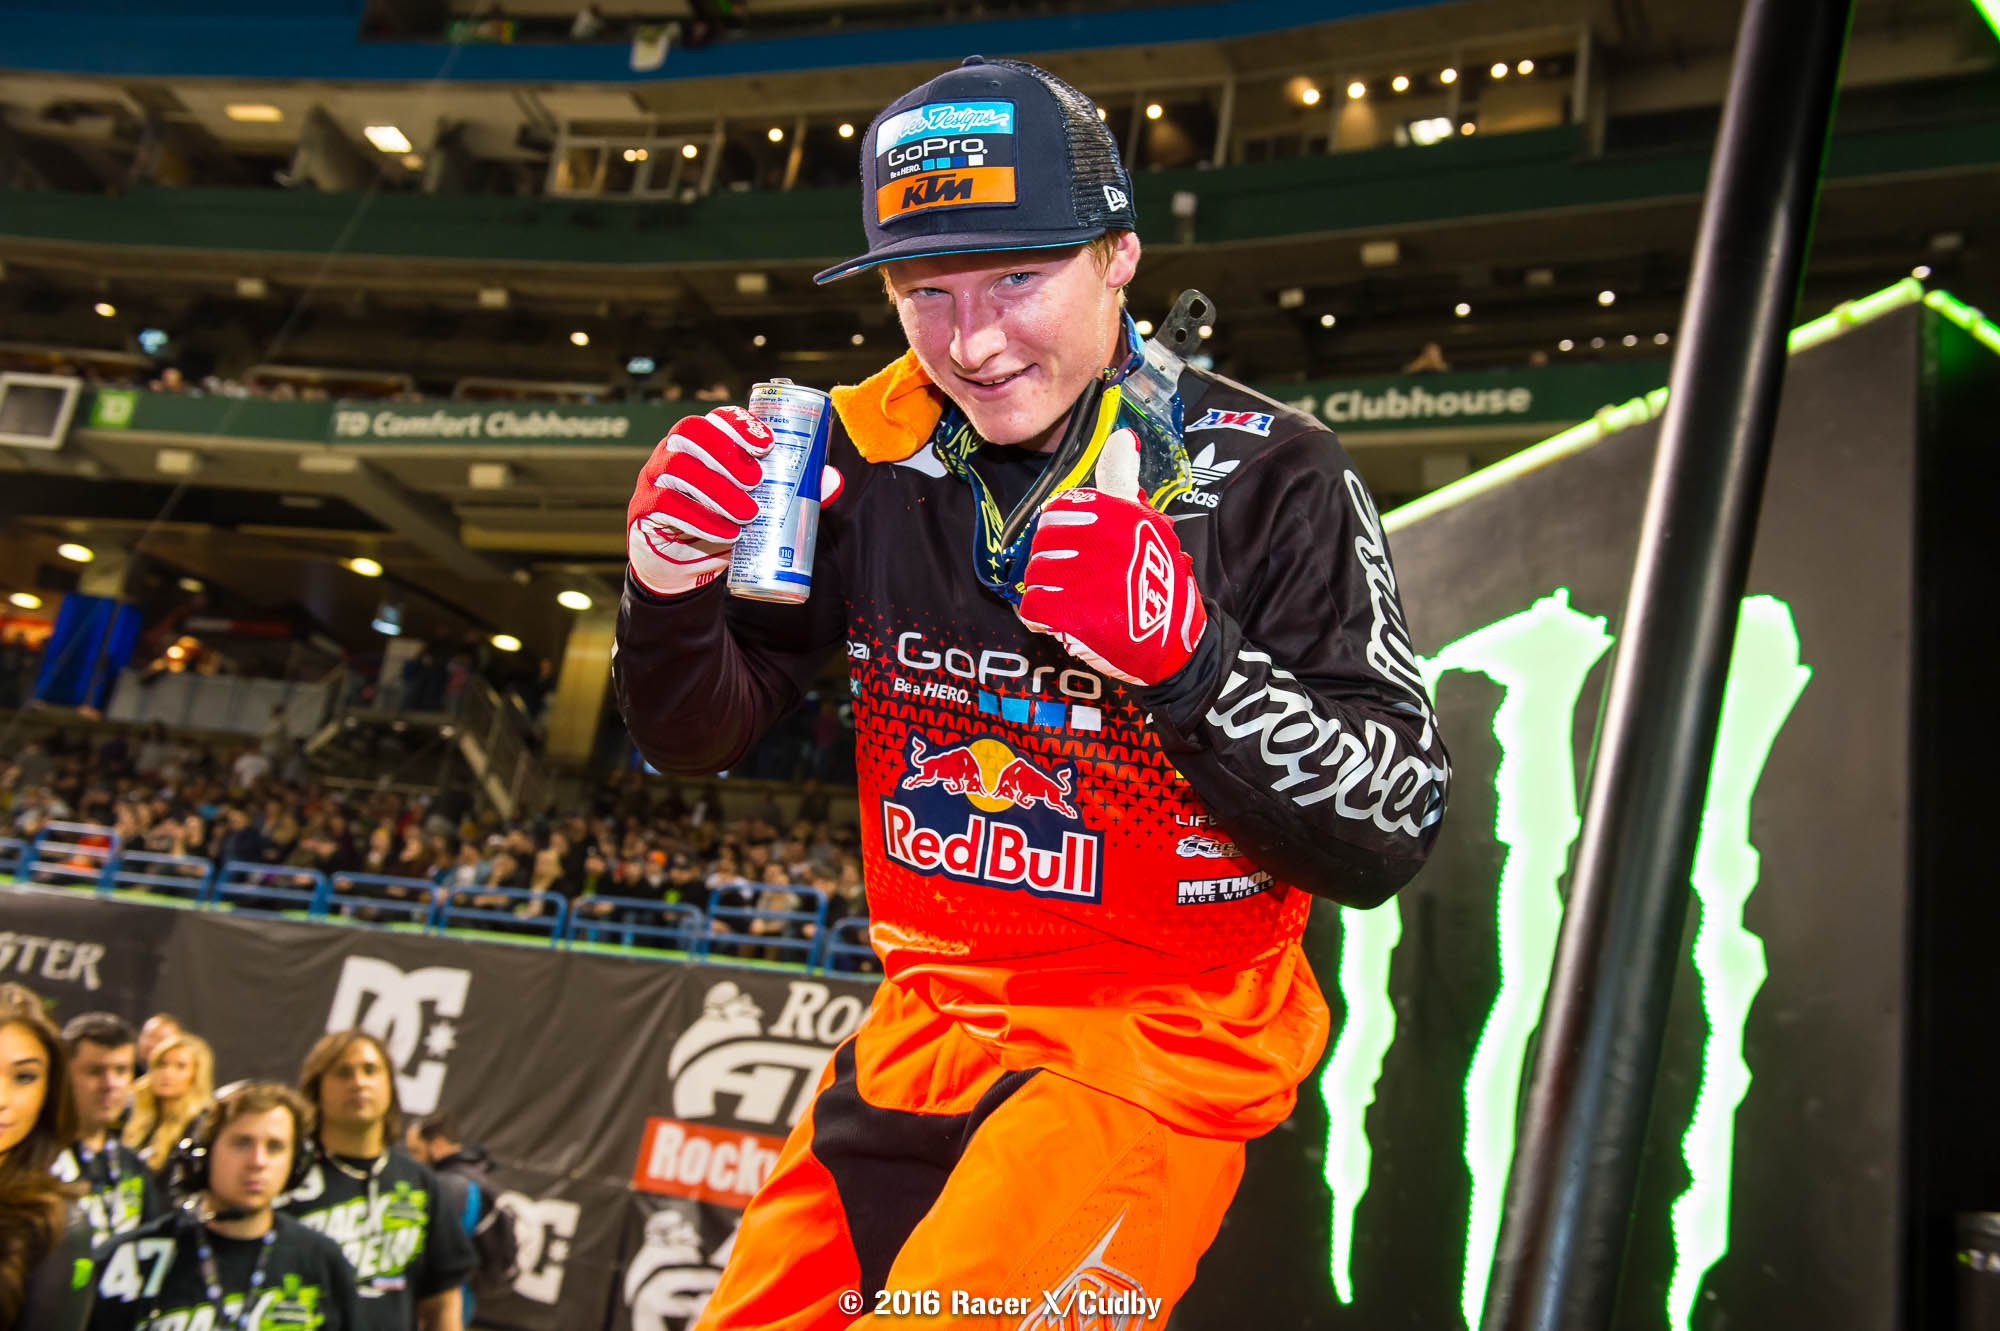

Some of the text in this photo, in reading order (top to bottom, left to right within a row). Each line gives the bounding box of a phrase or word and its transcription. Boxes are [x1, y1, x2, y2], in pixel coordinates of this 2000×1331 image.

[888, 138, 984, 166] GoPro
[901, 173, 974, 209] KTM
[1323, 386, 1532, 422] Clubhouse
[336, 410, 629, 438] TD Comfort Clubhouse
[1185, 408, 1275, 437] AMA
[897, 631, 1102, 700] GoPro
[893, 676, 911, 693] Be
[912, 684, 921, 695] a
[884, 801, 1098, 897] Red Bull
[1178, 895, 1216, 904] RACE
[326, 955, 472, 1115] DC
[99, 1237, 176, 1302] 47
